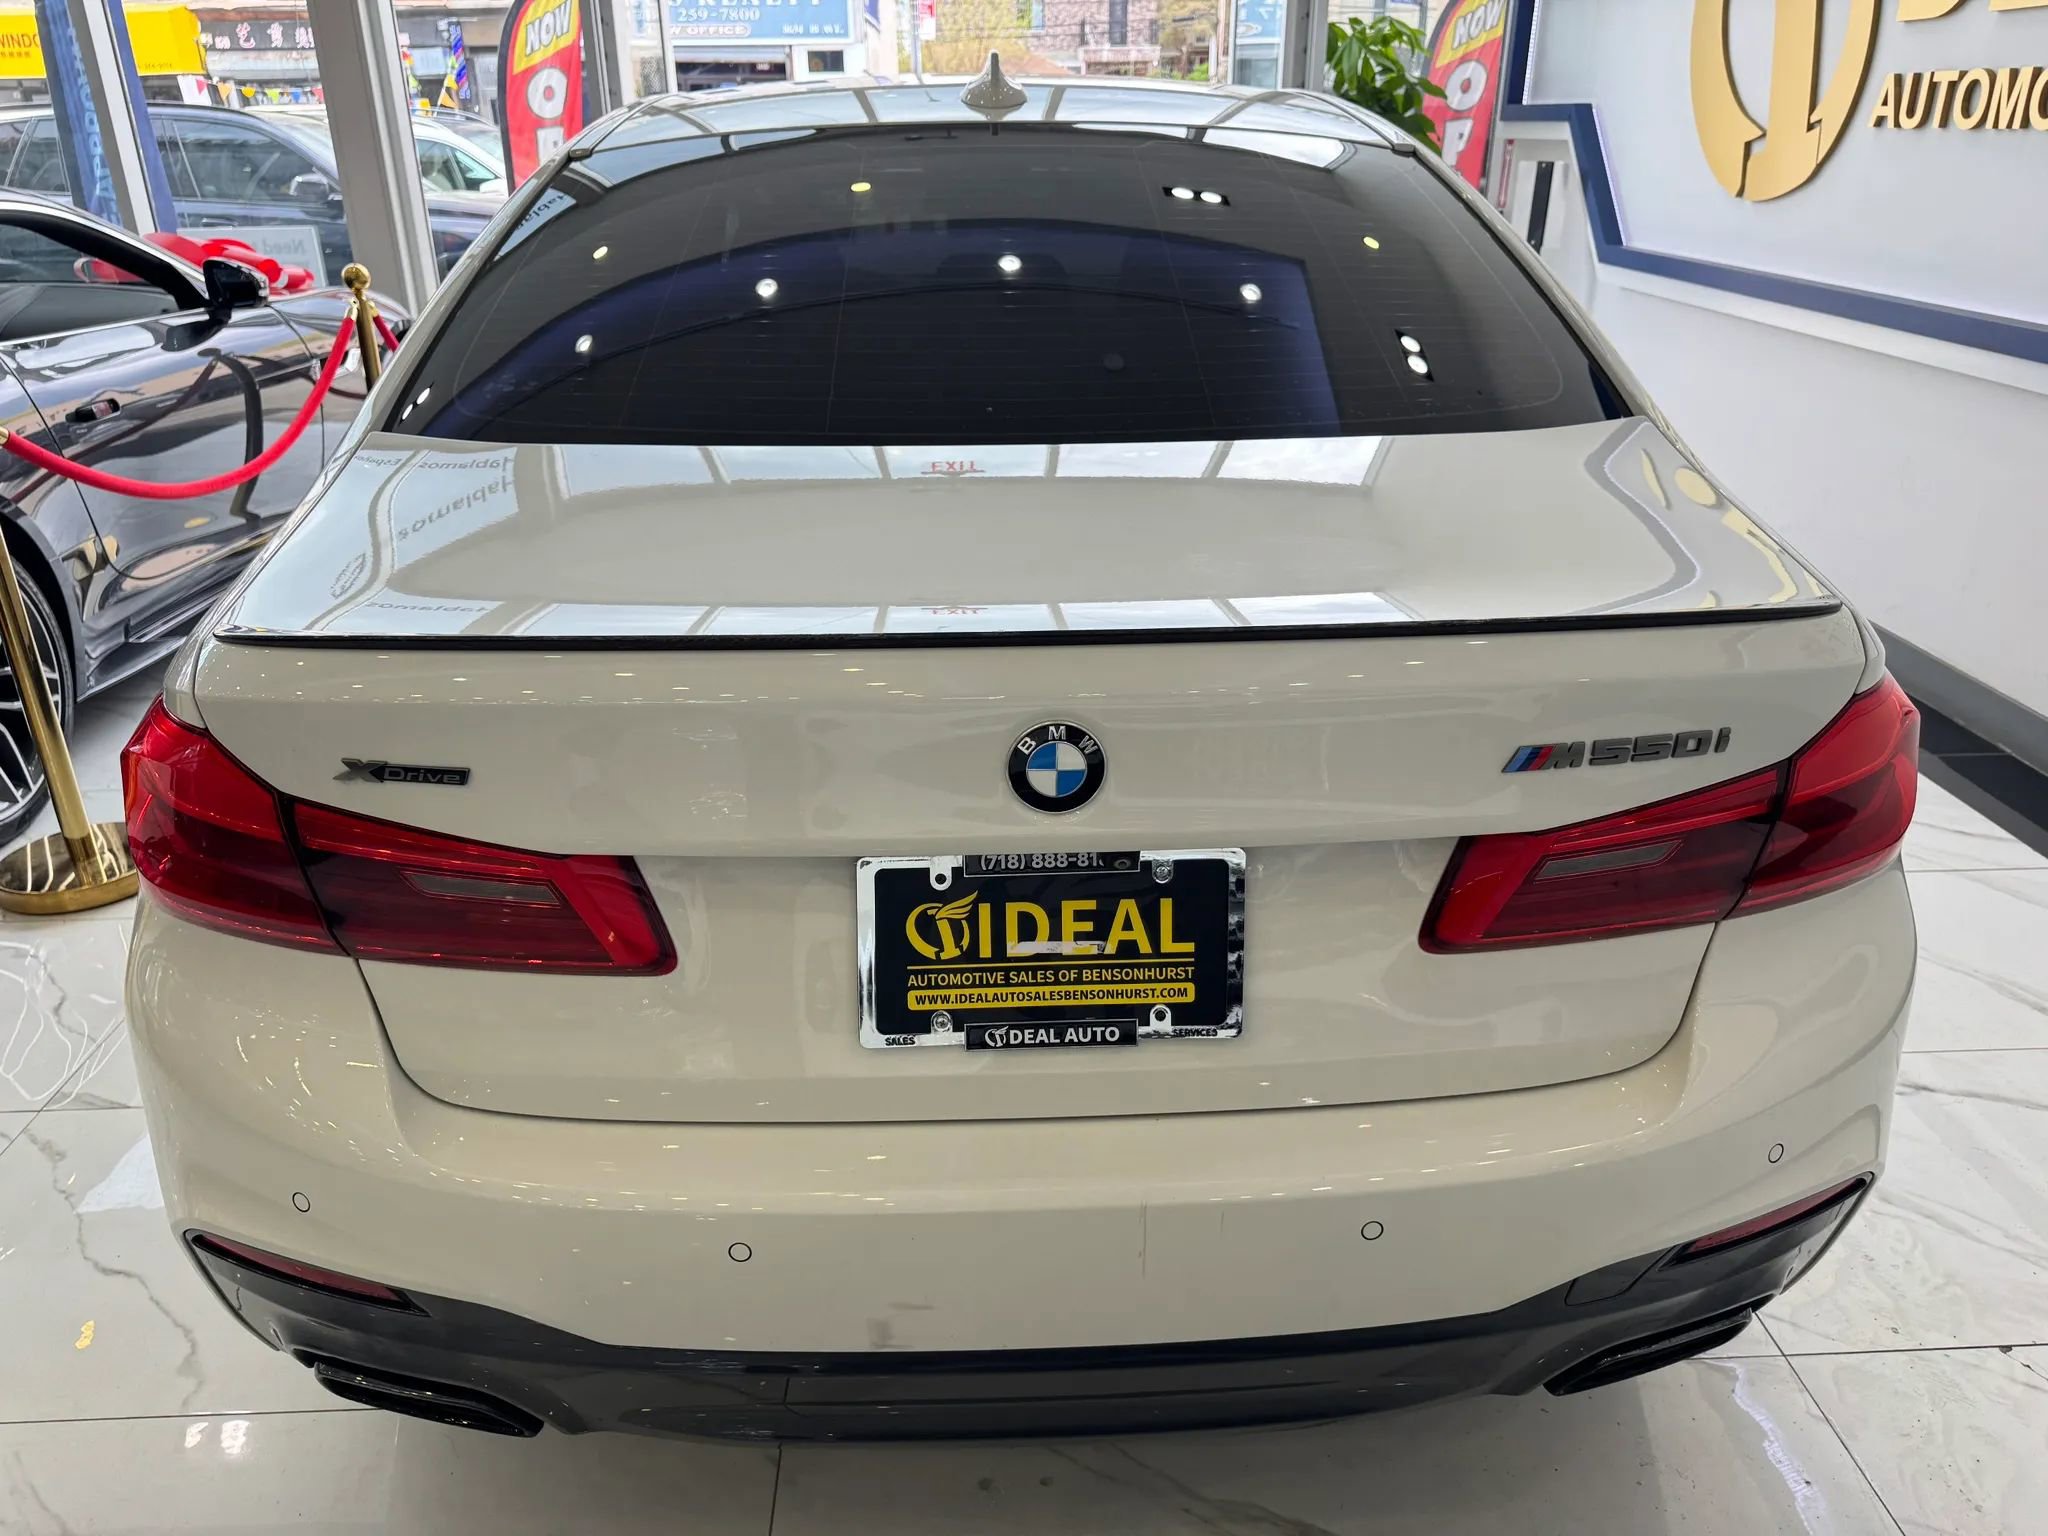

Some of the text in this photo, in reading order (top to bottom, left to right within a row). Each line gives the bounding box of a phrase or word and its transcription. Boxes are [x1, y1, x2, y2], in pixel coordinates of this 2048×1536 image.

[526, 0, 572, 56] NOW
[686, 26, 746, 35] OFFICE
[1453, 0, 1501, 49] NOW
[1017, 725, 1099, 756] BMW
[1502, 727, 1731, 773] M550i
[980, 853, 1104, 870] (718) 888-81
[978, 897, 1195, 958] IDEAL
[907, 966, 1195, 988] AUTOMOTIVE SALES OF BENSONHURST
[915, 987, 1188, 1006] WWW.IDEALAUTOSALESBENSONHURST.COM
[885, 1036, 916, 1046] SALES
[1064, 1026, 1120, 1044] AUTO
[1172, 1028, 1218, 1037] SERVICES
